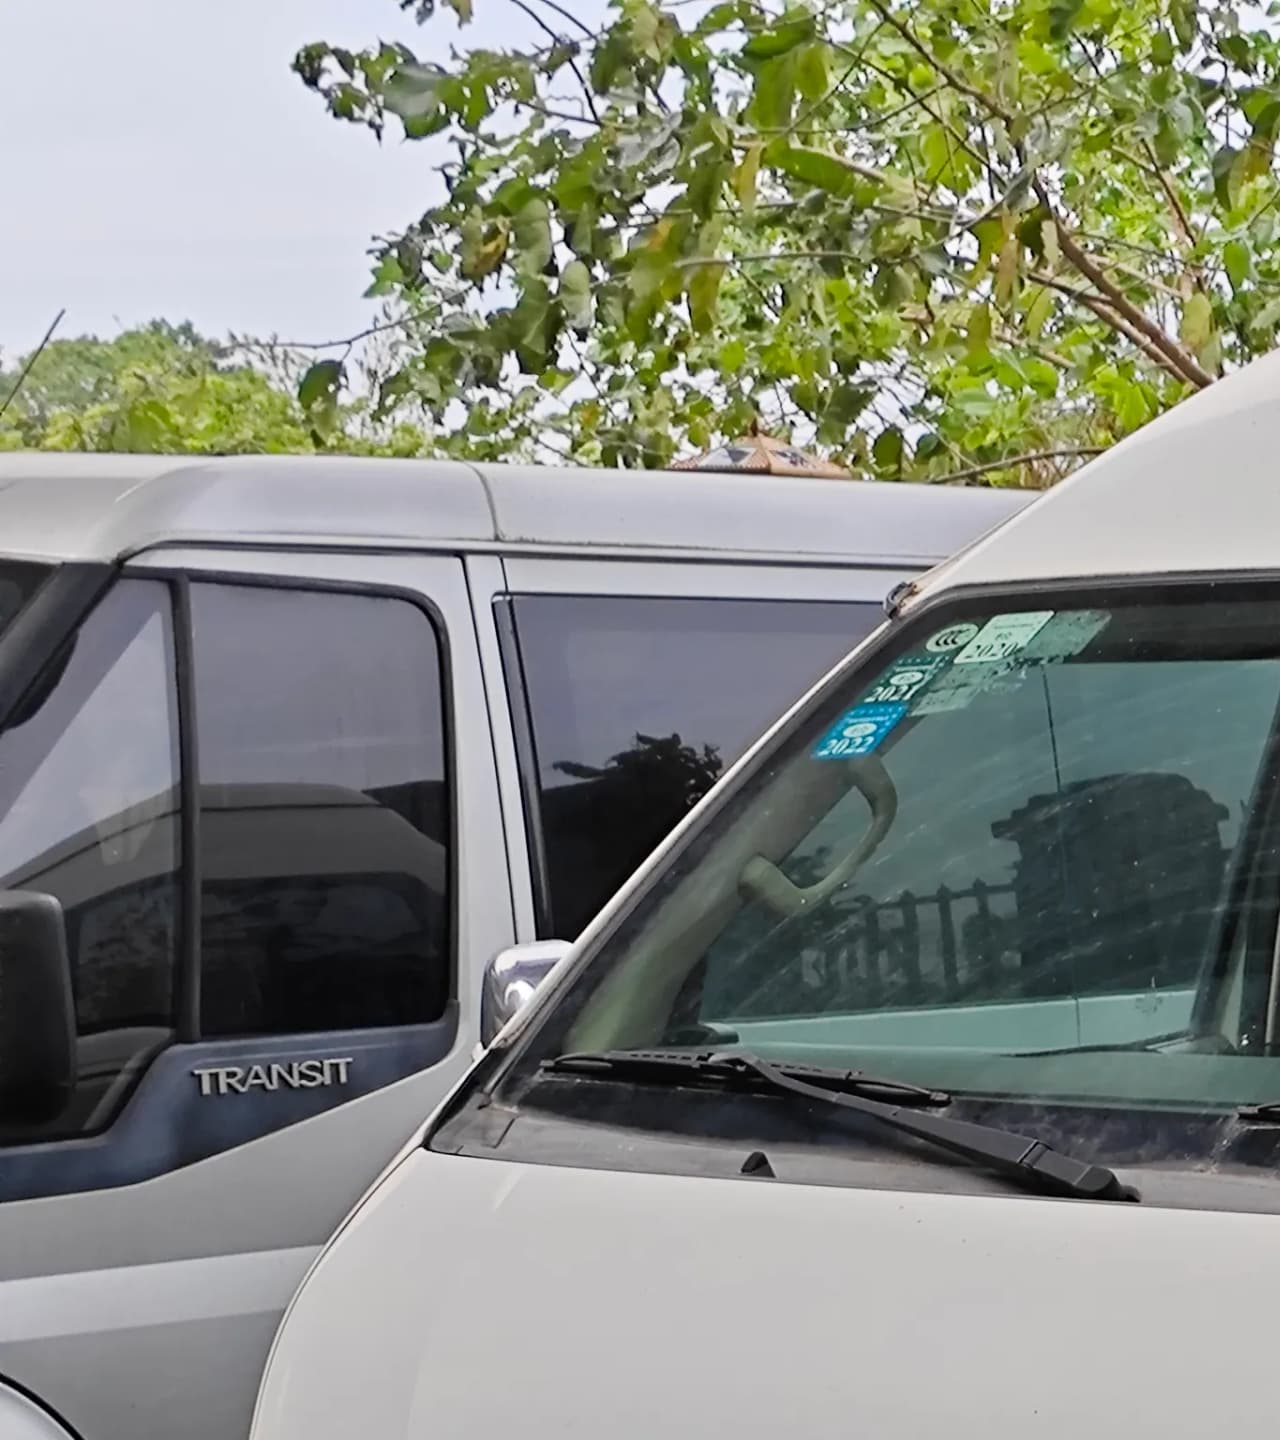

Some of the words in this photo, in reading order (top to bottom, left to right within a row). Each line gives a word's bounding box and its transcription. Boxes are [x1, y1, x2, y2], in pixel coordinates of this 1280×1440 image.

[864, 685, 916, 703] 2021
[817, 736, 875, 756] 2022
[194, 1057, 353, 1096] TRANSIT
